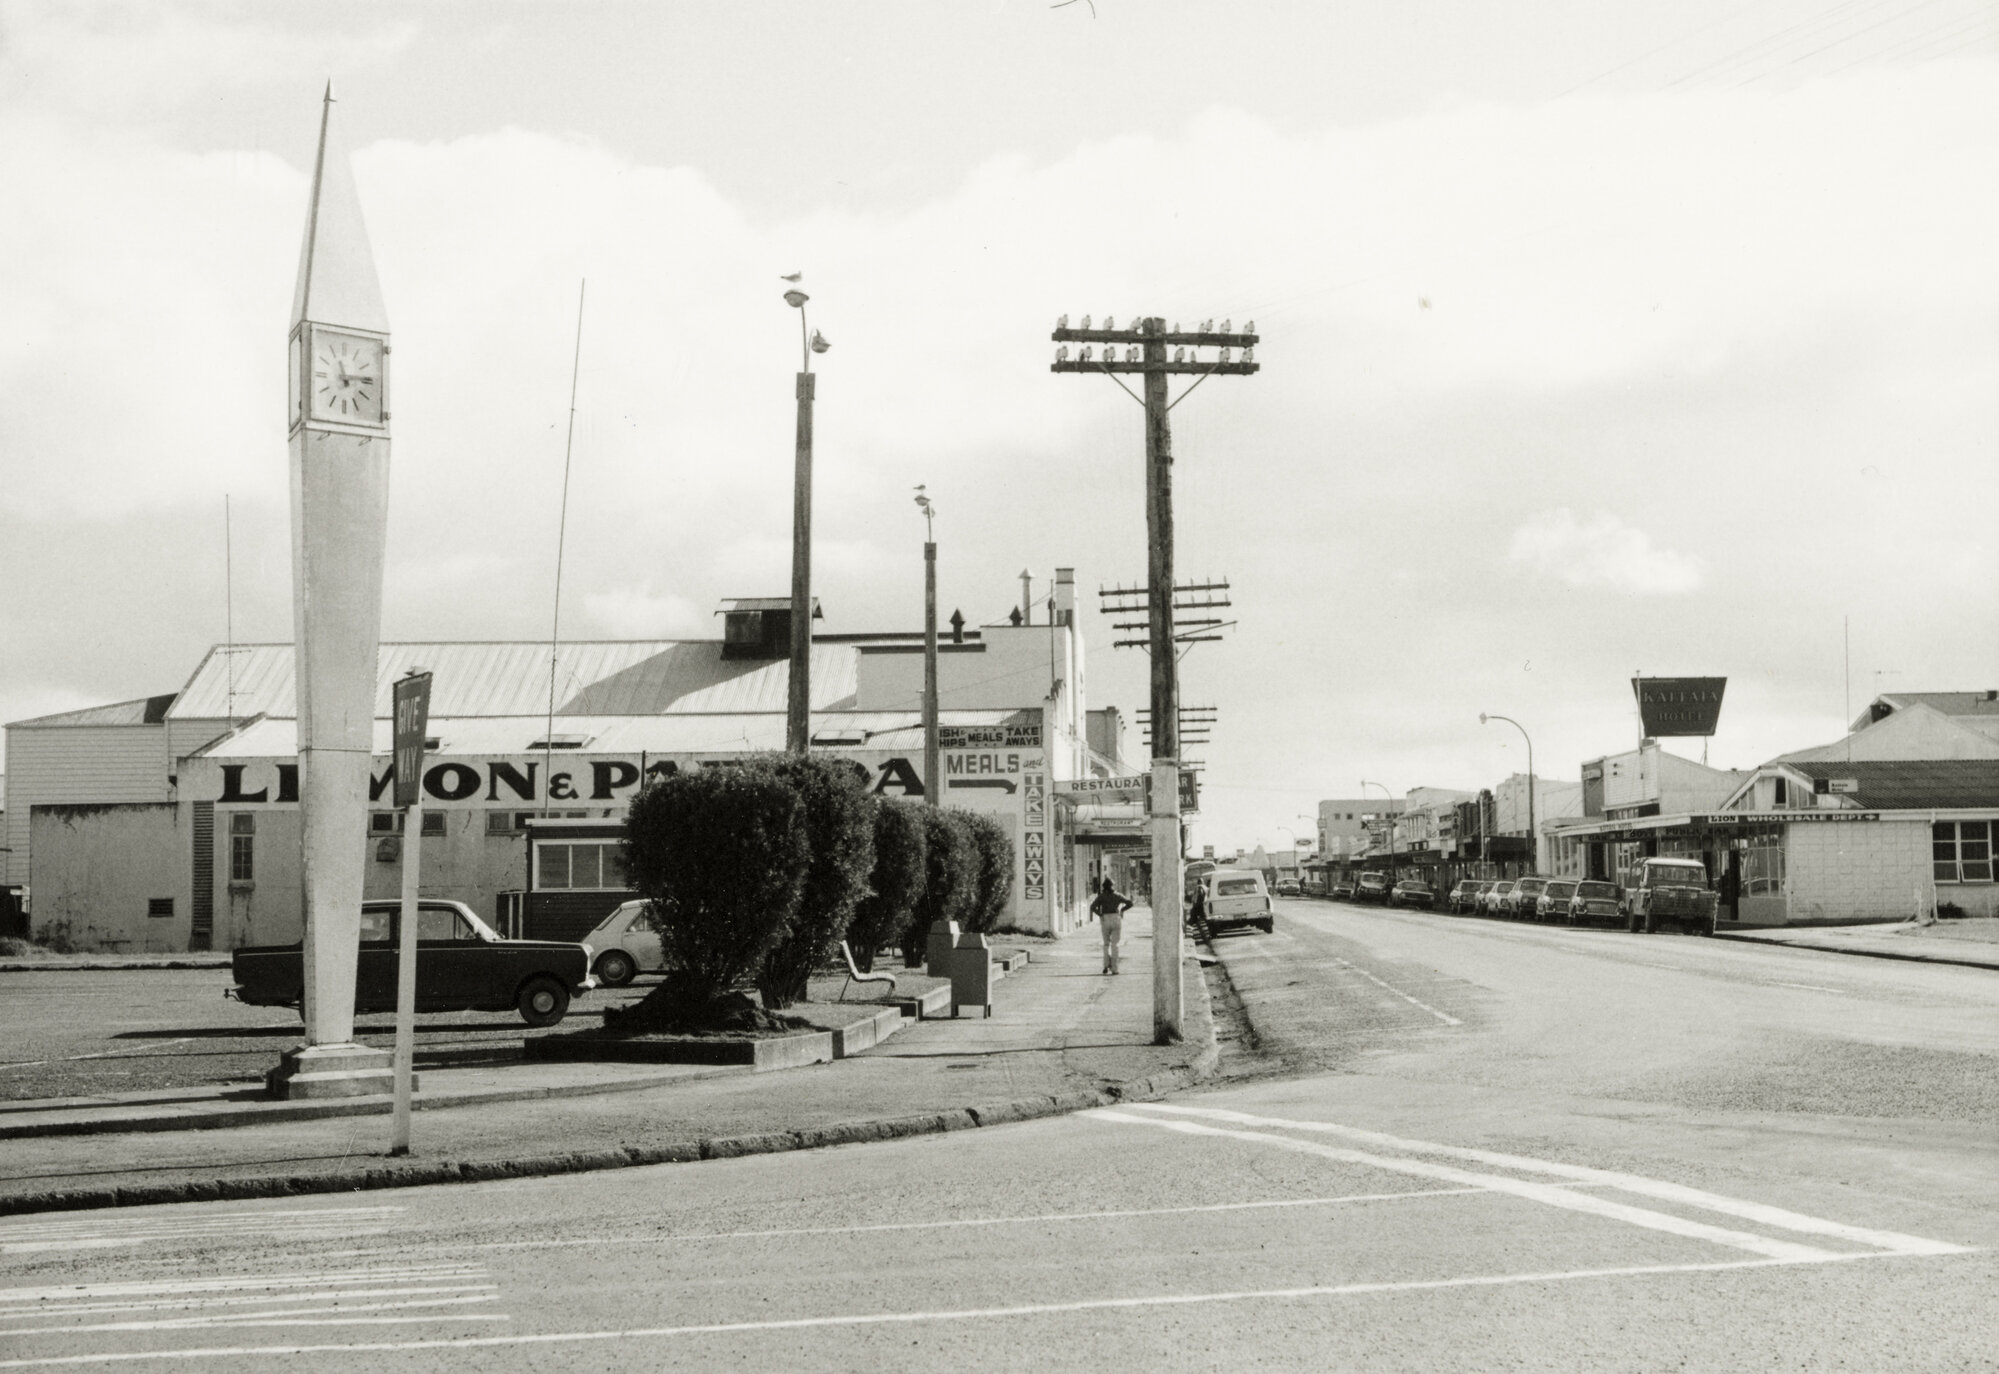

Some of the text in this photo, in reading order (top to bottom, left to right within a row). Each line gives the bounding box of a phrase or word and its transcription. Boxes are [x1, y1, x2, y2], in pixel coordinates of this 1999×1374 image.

[398, 696, 421, 735] GIVE
[939, 729, 960, 737] ISH
[1006, 727, 1039, 736] TAKE
[939, 738, 966, 747] HIPS
[968, 733, 1003, 742] MEALS
[1005, 737, 1040, 746] AWAYS
[397, 746, 417, 784] WAY
[946, 754, 1019, 774] MEALS
[1023, 757, 1045, 768] and
[217, 762, 539, 803] LON
[549, 772, 579, 799] &
[1072, 779, 1141, 791] RESTAURA
[1747, 814, 1827, 822] WHOLESALE
[1025, 774, 1043, 899] TAKE AWAYS
